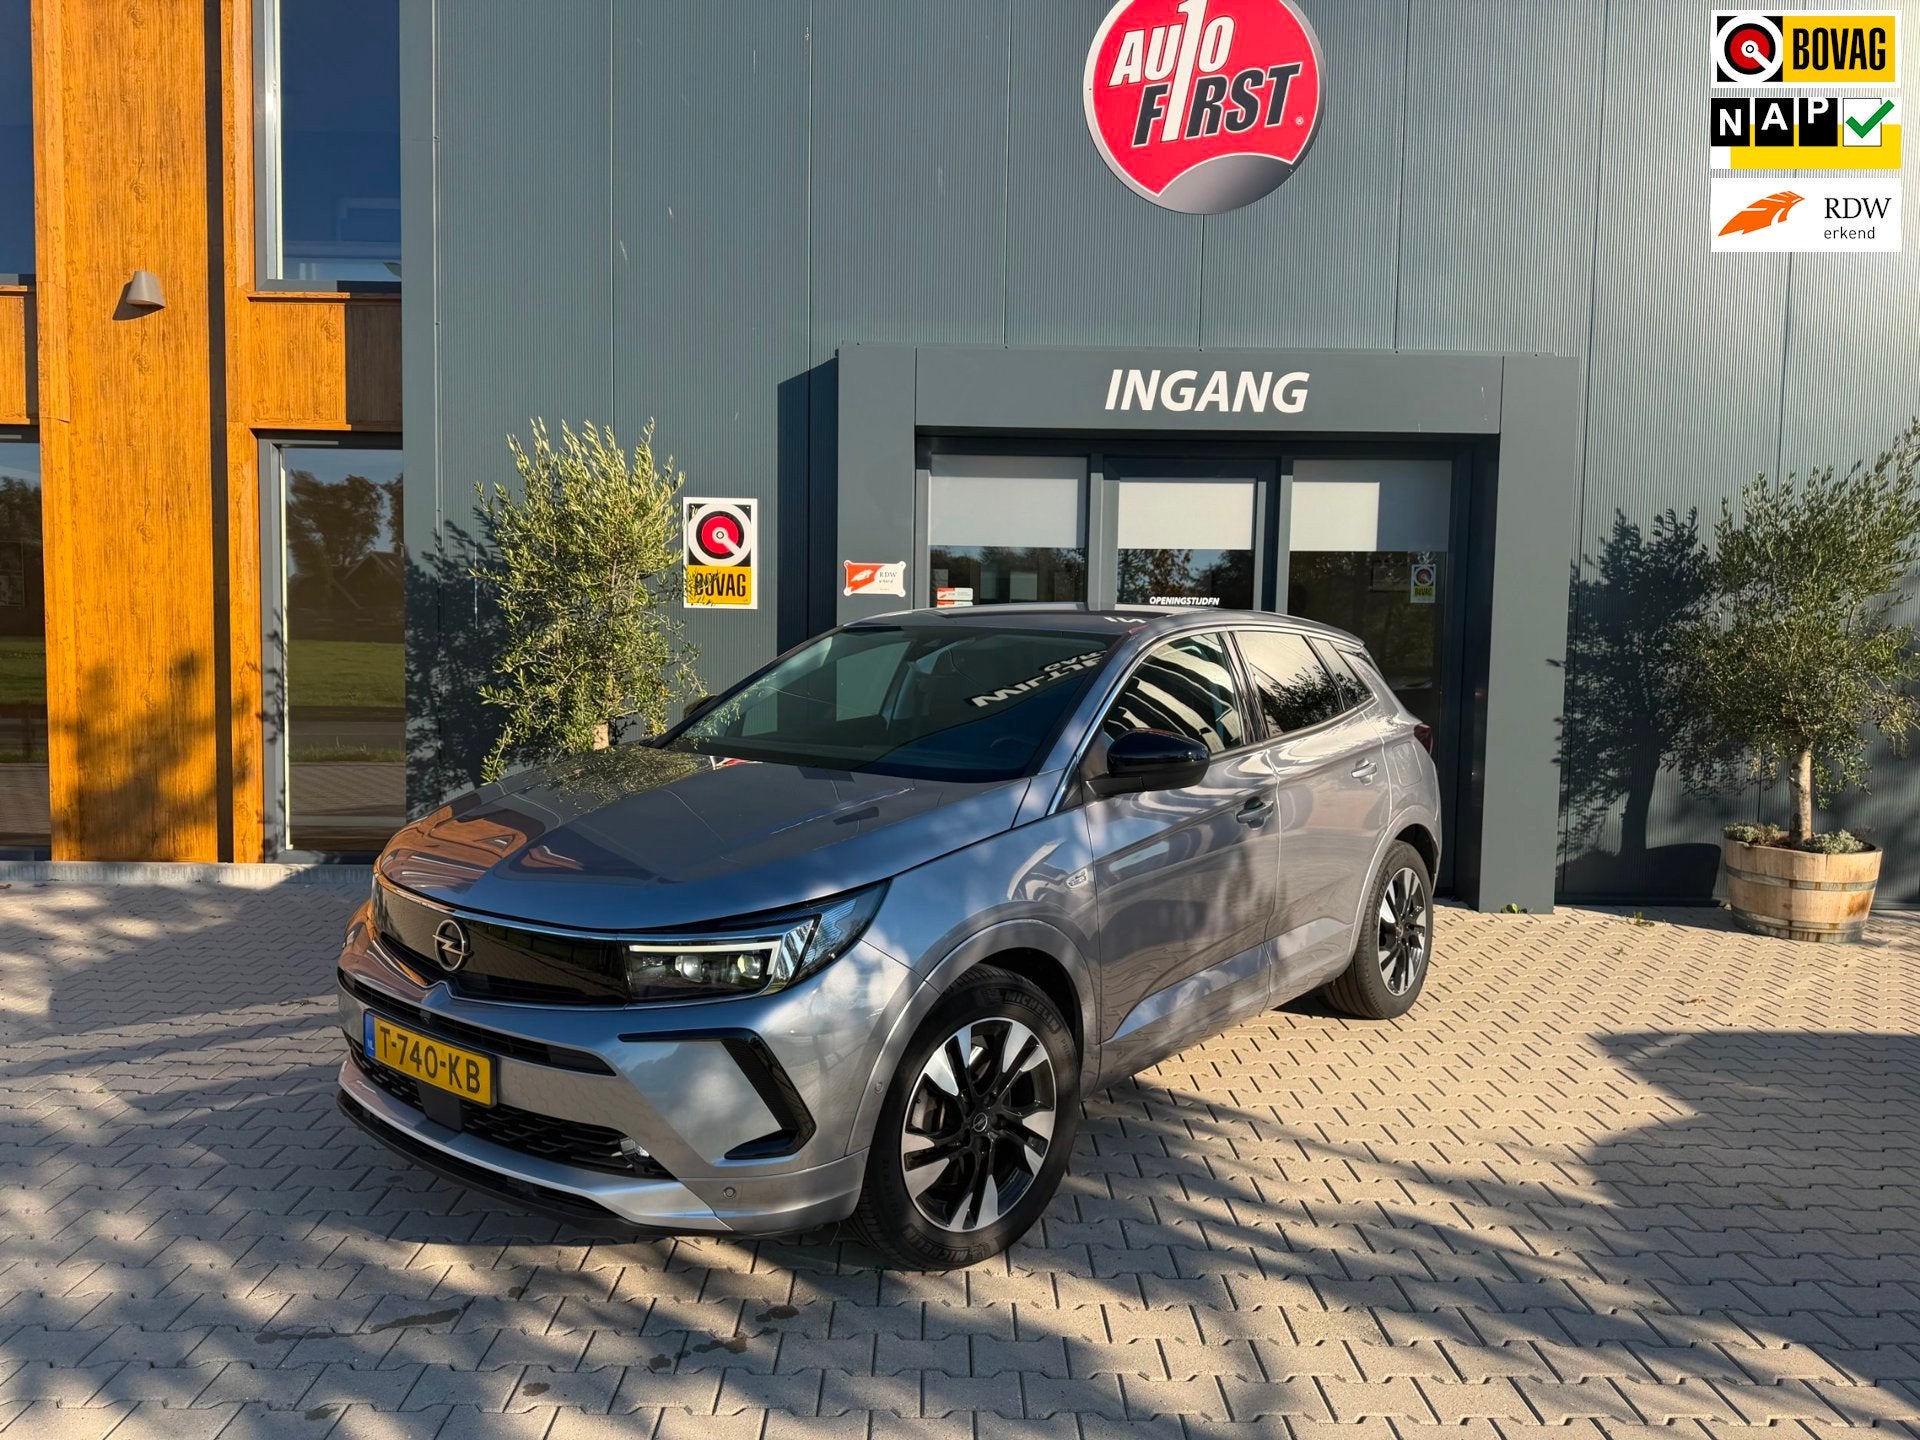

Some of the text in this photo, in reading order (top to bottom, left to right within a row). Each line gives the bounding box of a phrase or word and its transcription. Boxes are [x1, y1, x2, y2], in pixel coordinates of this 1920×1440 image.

[1105, 369, 1310, 413] INGANG
[695, 572, 746, 597] BOVAG
[379, 1025, 481, 1094] T-740-KB
